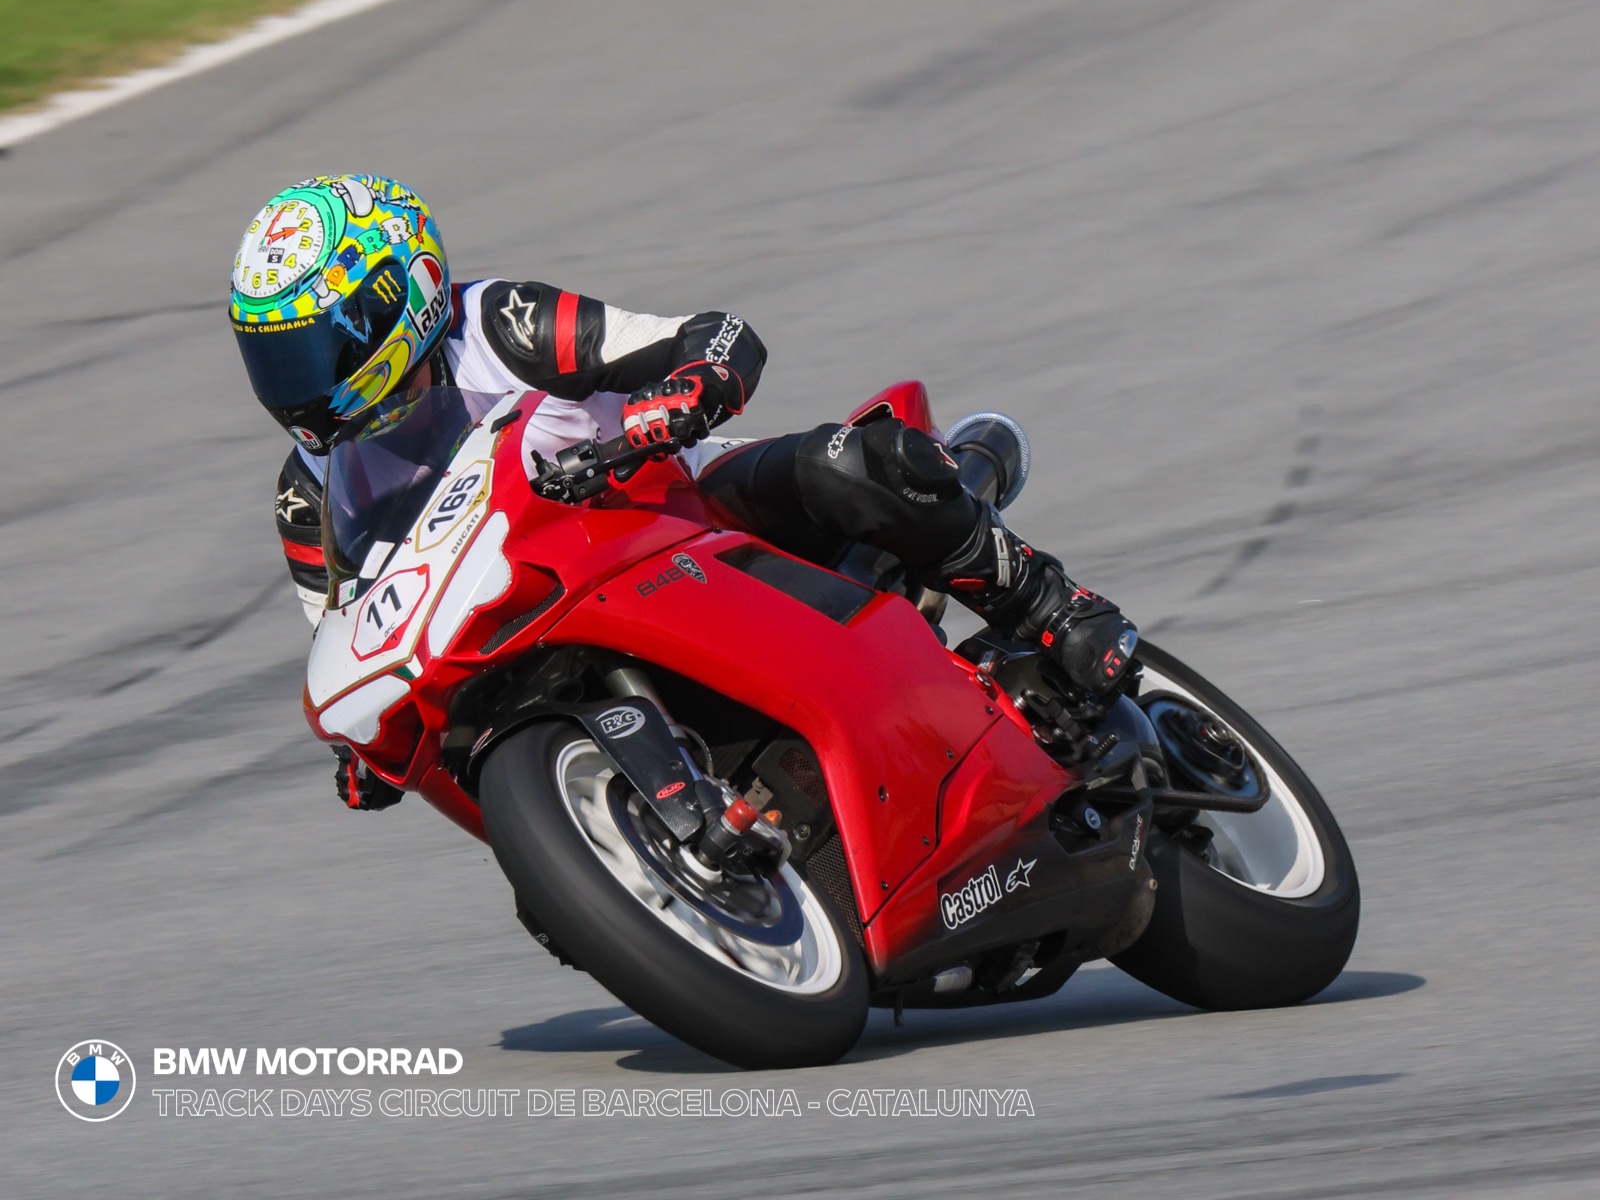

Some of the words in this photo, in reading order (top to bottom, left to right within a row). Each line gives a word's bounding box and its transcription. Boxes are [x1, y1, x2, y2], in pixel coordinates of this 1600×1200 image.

[277, 201, 299, 212] 12
[297, 207, 308, 219] 1
[298, 218, 313, 232] 2
[299, 235, 313, 250] 3
[284, 253, 297, 268] 4
[252, 272, 262, 289] 6
[266, 269, 279, 285] 5
[258, 317, 316, 333] CHIHUAHUA
[428, 474, 481, 533] 165
[451, 514, 480, 555] DUCATI
[366, 583, 402, 630] 11
[601, 710, 637, 733] R&G
[941, 865, 1003, 930] Castrol
